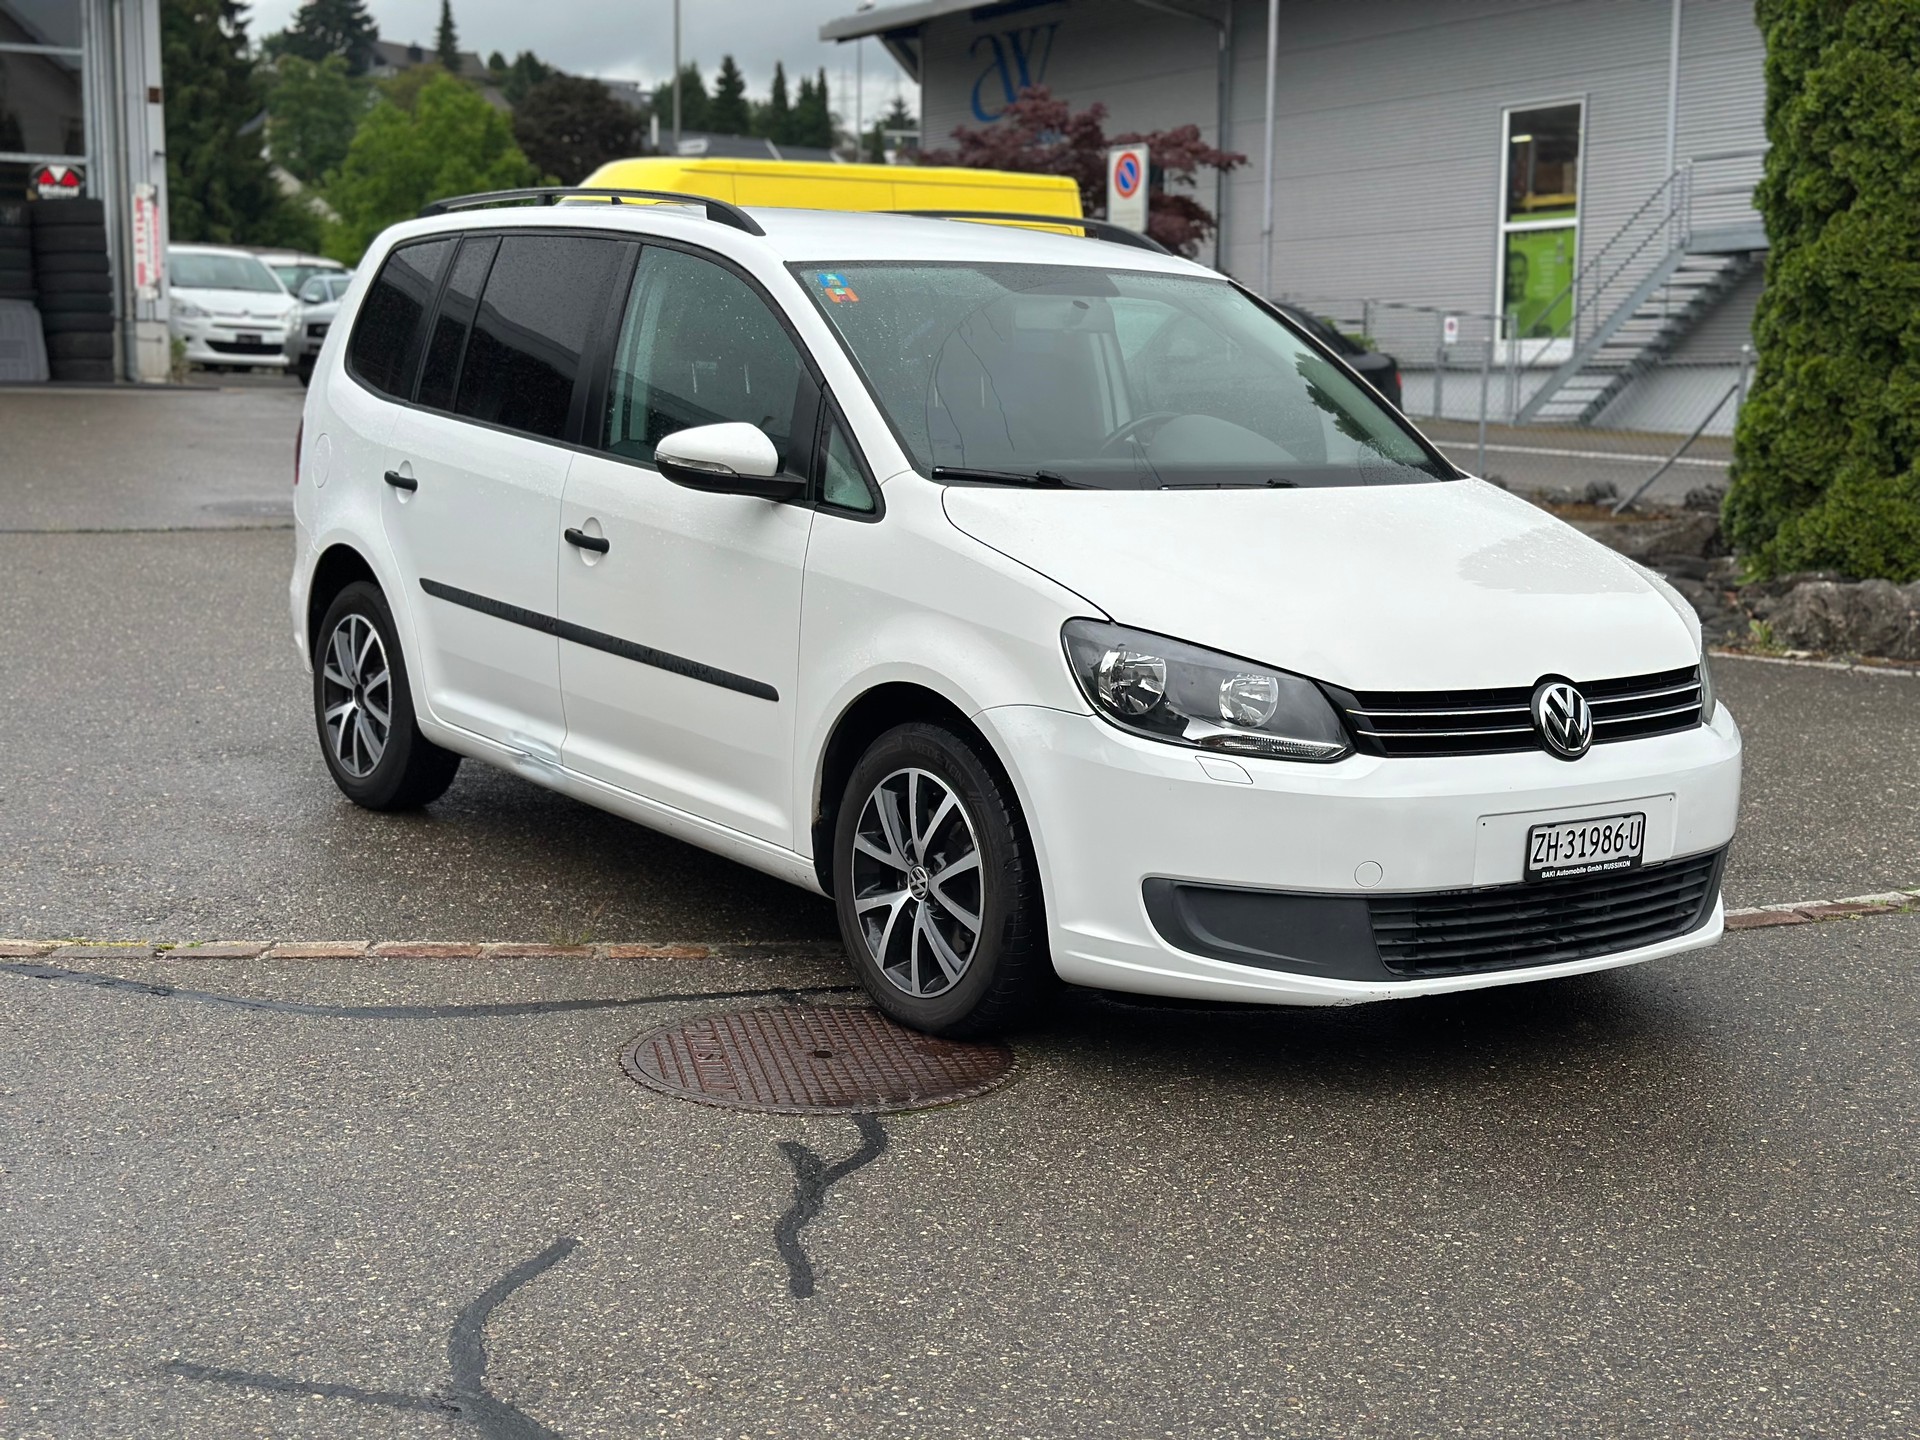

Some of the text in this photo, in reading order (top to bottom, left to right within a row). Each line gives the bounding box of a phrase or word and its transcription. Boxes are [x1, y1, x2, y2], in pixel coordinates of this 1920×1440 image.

[1541, 870, 1556, 878] BAKI
[1556, 866, 1587, 876] Automobile
[1603, 860, 1631, 870] RUSSIKON
